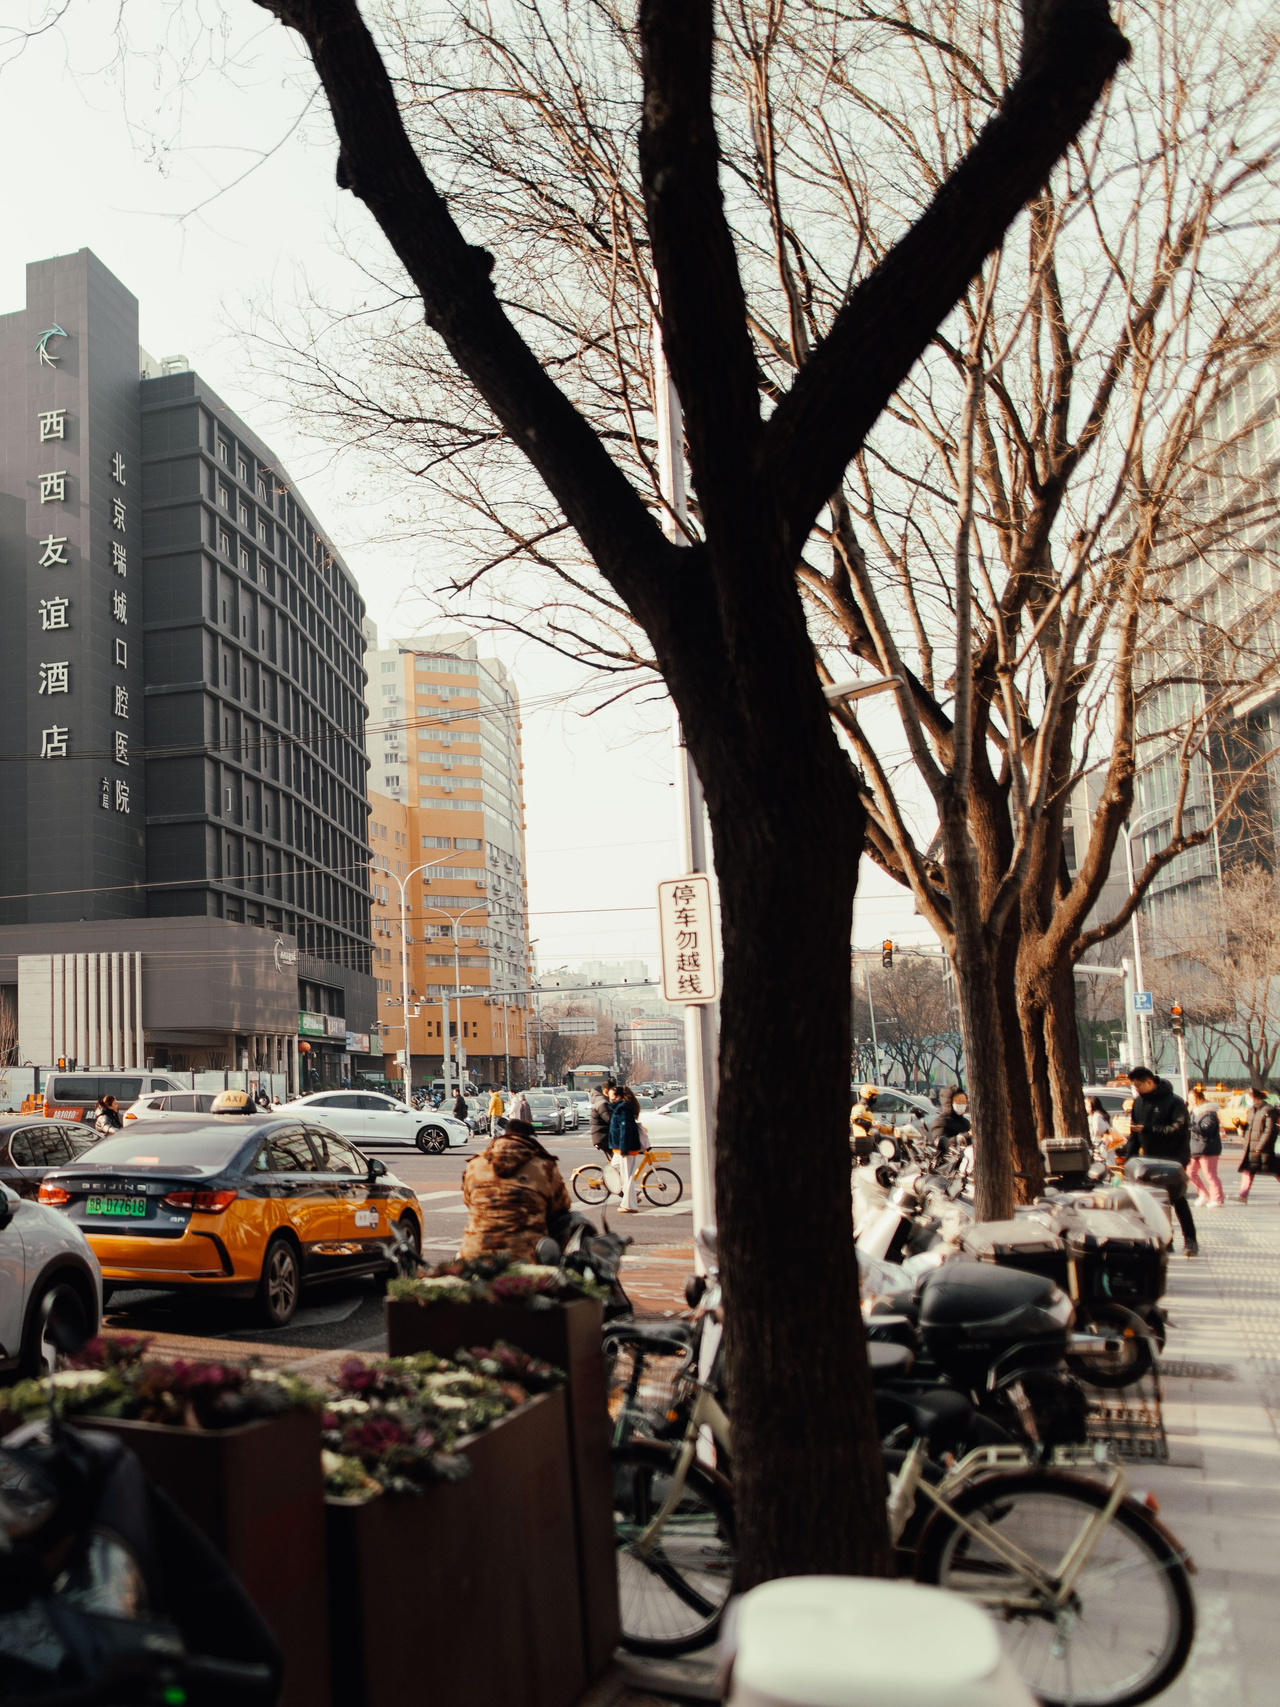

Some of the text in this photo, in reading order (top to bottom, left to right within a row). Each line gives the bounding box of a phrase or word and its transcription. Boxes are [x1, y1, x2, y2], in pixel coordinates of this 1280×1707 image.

[37, 408, 70, 760] 西西友谊酒店
[112, 451, 131, 814] 北京瑞城口腔医院
[672, 884, 702, 994] 停车勿越线
[1135, 995, 1147, 1008] P
[81, 1182, 147, 1191] BEIJING
